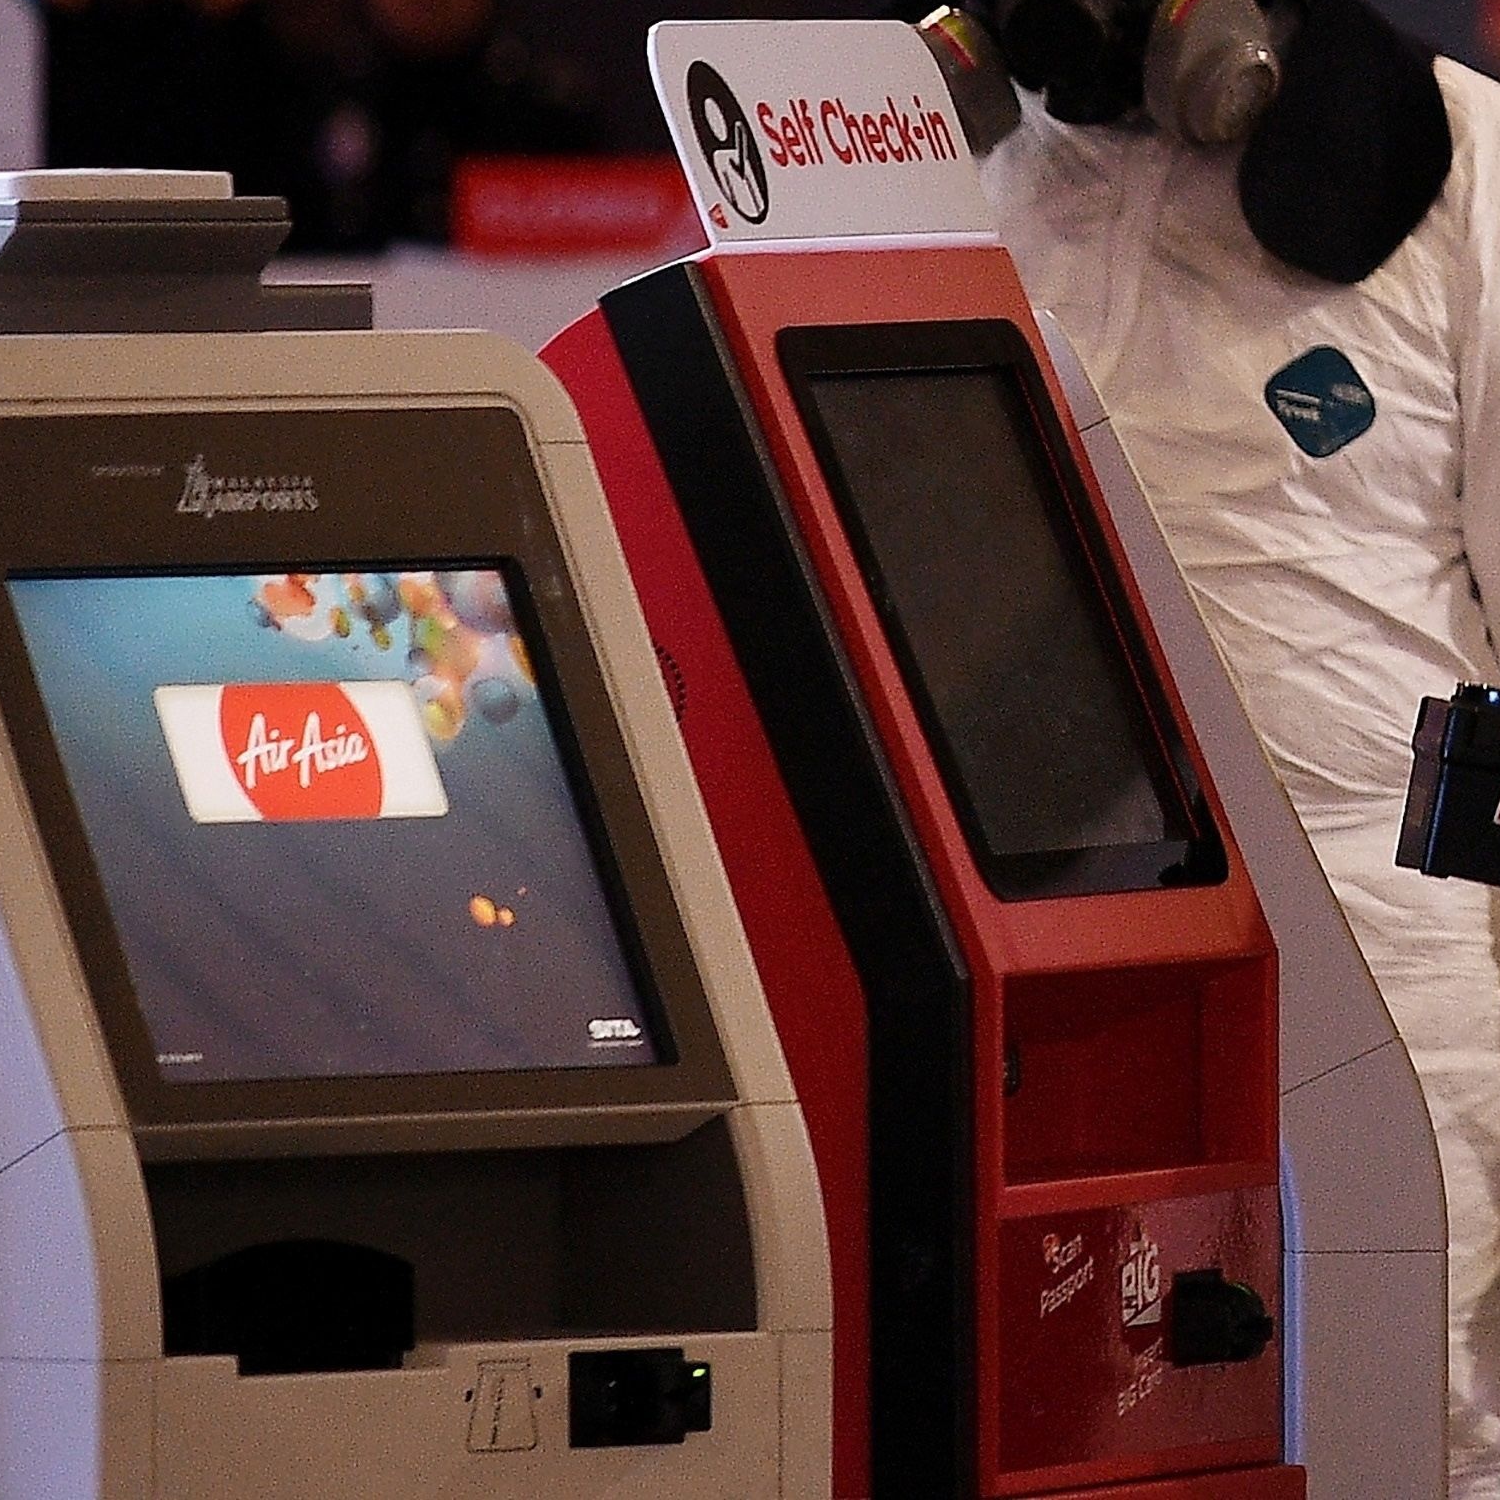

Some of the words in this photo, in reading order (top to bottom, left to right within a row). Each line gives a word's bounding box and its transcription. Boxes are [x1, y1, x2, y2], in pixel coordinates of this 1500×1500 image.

[756, 98, 823, 167] Self
[820, 94, 958, 165] Check-in
[1039, 1256, 1095, 1320] Passport
